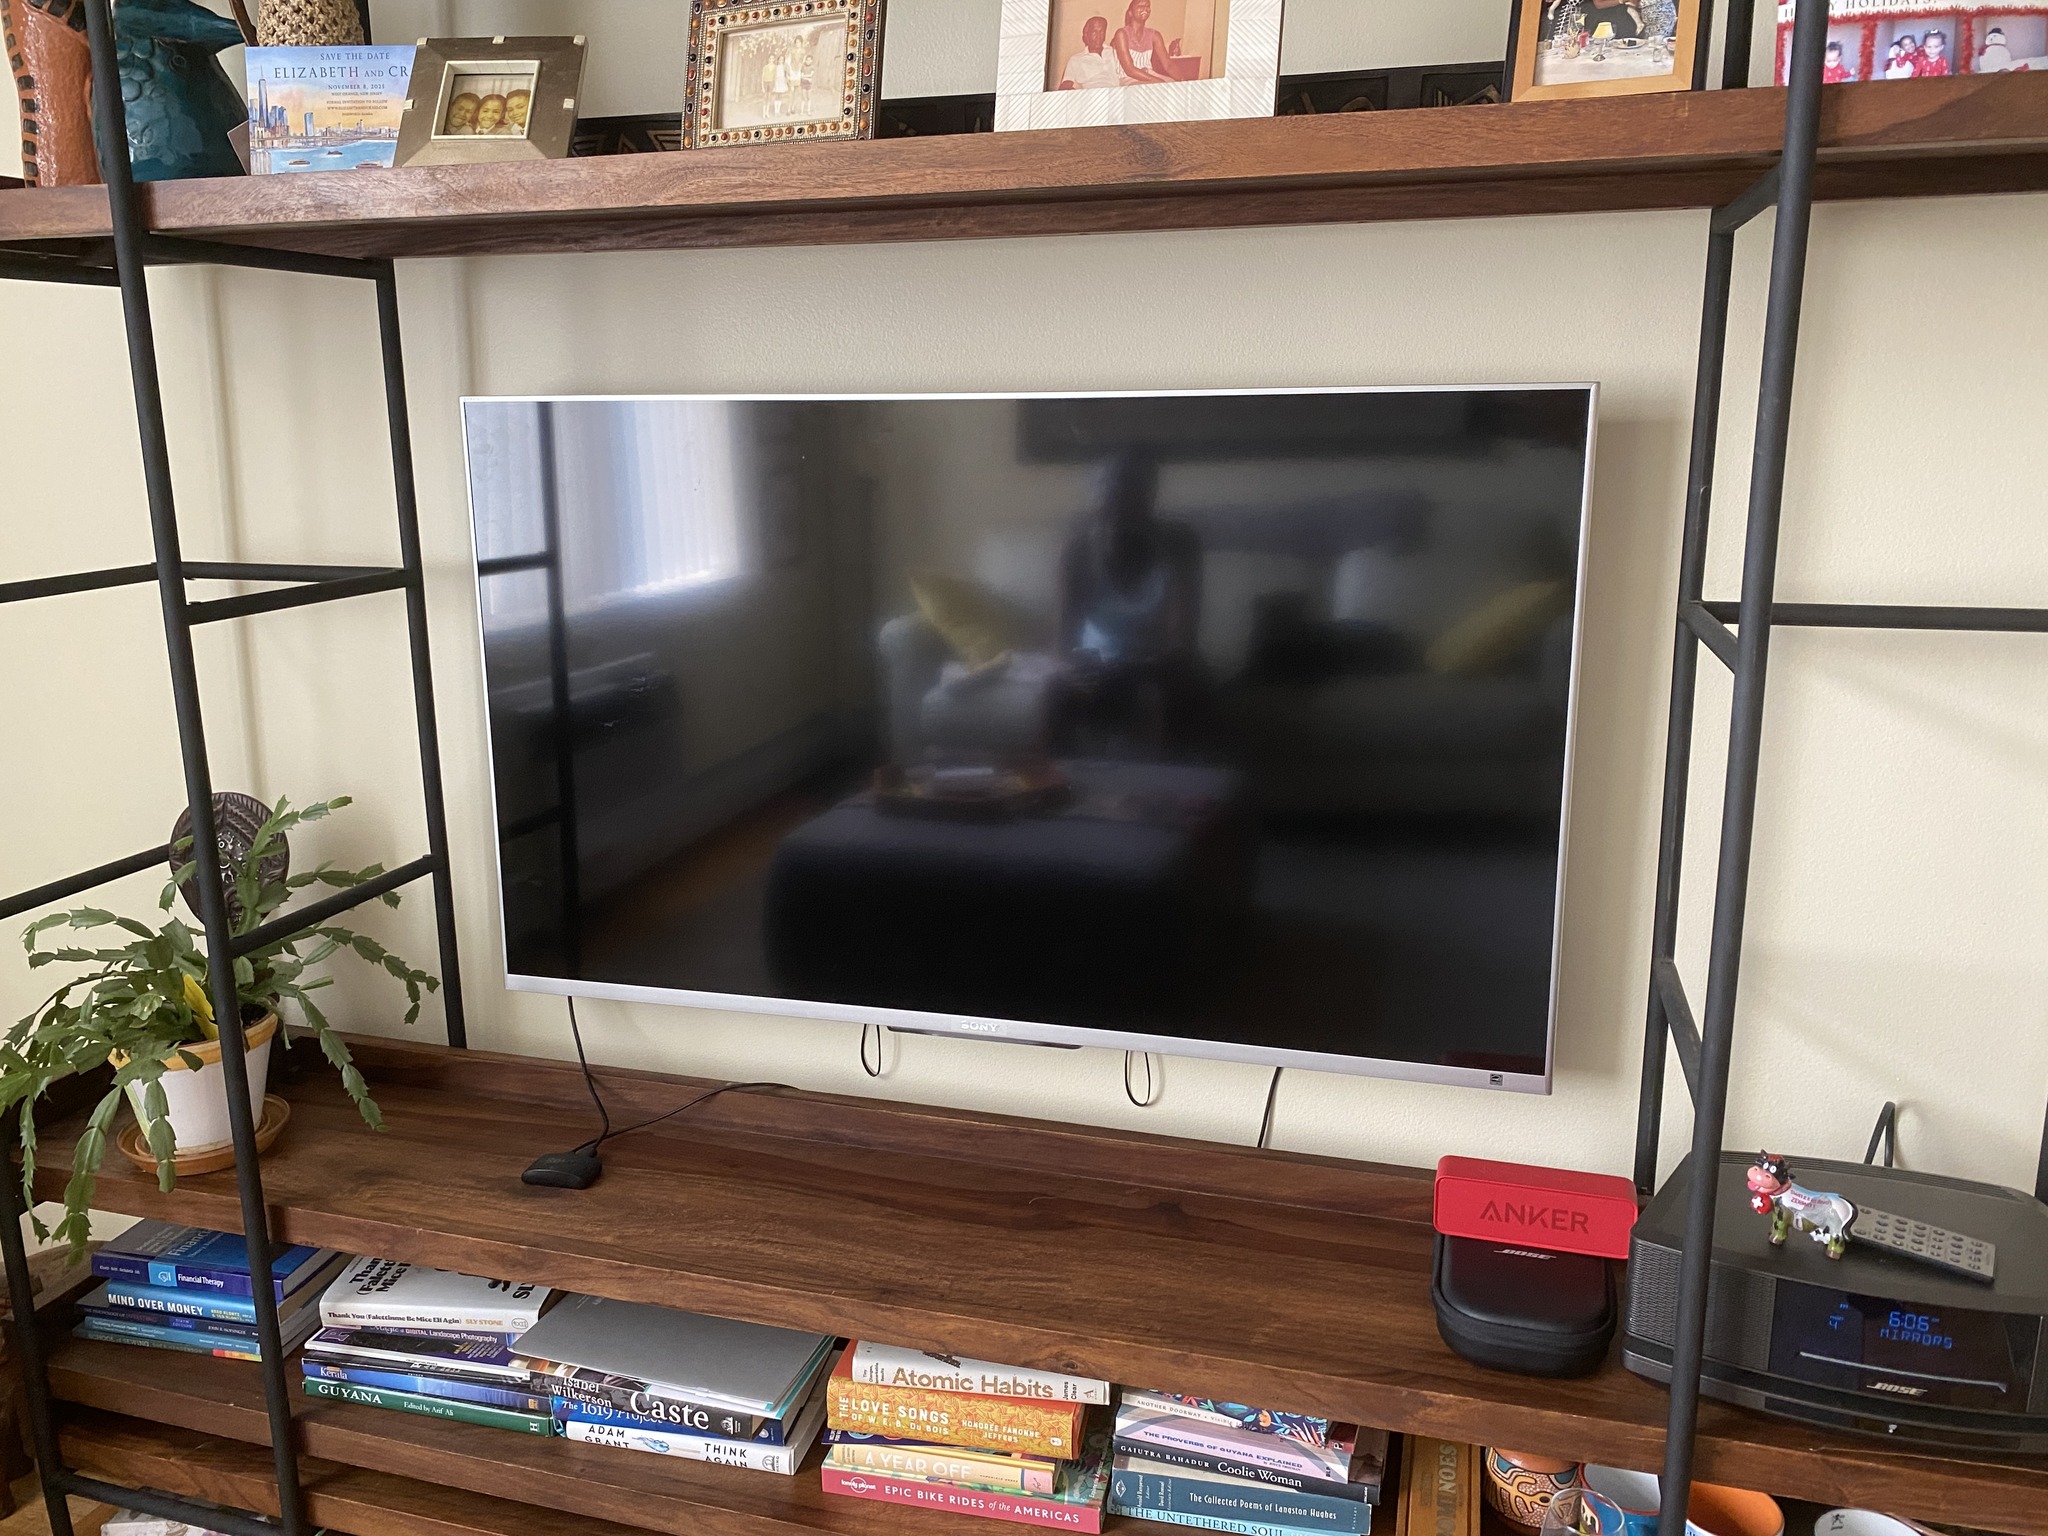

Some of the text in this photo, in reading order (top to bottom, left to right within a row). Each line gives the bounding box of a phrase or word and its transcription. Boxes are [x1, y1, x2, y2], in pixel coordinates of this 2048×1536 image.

[320, 52, 390, 61] SAVE THE DATE
[274, 66, 359, 79] ELIZABETH
[364, 70, 384, 78] AND
[960, 1020, 1000, 1032] SONY
[1479, 1199, 1589, 1234] ANKER
[1493, 1249, 1557, 1260] BOSE
[178, 1273, 224, 1288] Financial Therapy
[108, 1293, 203, 1316] MIND OVER MONEY
[327, 1311, 351, 1319] Thank
[416, 1315, 432, 1323] Mice
[1888, 1310, 1929, 1332] 6:06
[405, 1328, 428, 1336] DIGITAL
[429, 1330, 460, 1339] Landscape
[460, 1332, 498, 1344] Photography
[1879, 1328, 1953, 1349] MIRRORS
[320, 1366, 348, 1380] Kerala
[892, 1366, 1053, 1399] Atomic Habits
[318, 1384, 383, 1405] GUYANA
[563, 1376, 600, 1393] Isabel
[1866, 1382, 1928, 1397] BOSE
[551, 1384, 613, 1408] Wilkerson
[403, 1401, 454, 1417] Edited by Arif Ali
[562, 1401, 579, 1410] The
[581, 1402, 613, 1420] 1619
[630, 1391, 709, 1430] Caste
[839, 1396, 849, 1418] THE
[851, 1398, 950, 1424] LOVE SONGS
[1136, 1400, 1167, 1411] ANOTHER
[1169, 1407, 1201, 1418] DOORWAY
[588, 1424, 625, 1438] ADAM
[851, 1413, 865, 1422] OF
[867, 1414, 879, 1424] W.
[882, 1417, 892, 1427] E.
[895, 1419, 906, 1429] B.
[926, 1423, 949, 1435] BOIS
[584, 1435, 630, 1448] GRANT
[704, 1442, 747, 1458] THINK
[1143, 1431, 1160, 1439] THE
[1161, 1435, 1204, 1448] PROVERBS
[1219, 1447, 1254, 1458] GUYANA
[1256, 1454, 1303, 1469] EXPLAINED
[865, 1450, 876, 1466] A
[880, 1452, 927, 1473] YEAR
[932, 1459, 973, 1479] OFF
[1120, 1445, 1303, 1488] GAIUTRA BAHADUR Coolie Woman
[841, 1479, 877, 1492] lonely planet
[884, 1485, 1080, 1524] EPIC BIKE RIDES of the AMERICAS
[1189, 1492, 1337, 1520] The Collected Poems of Langston Hughes
[1127, 1506, 1153, 1519] THE
[1156, 1511, 1247, 1533] UNTETHERED
